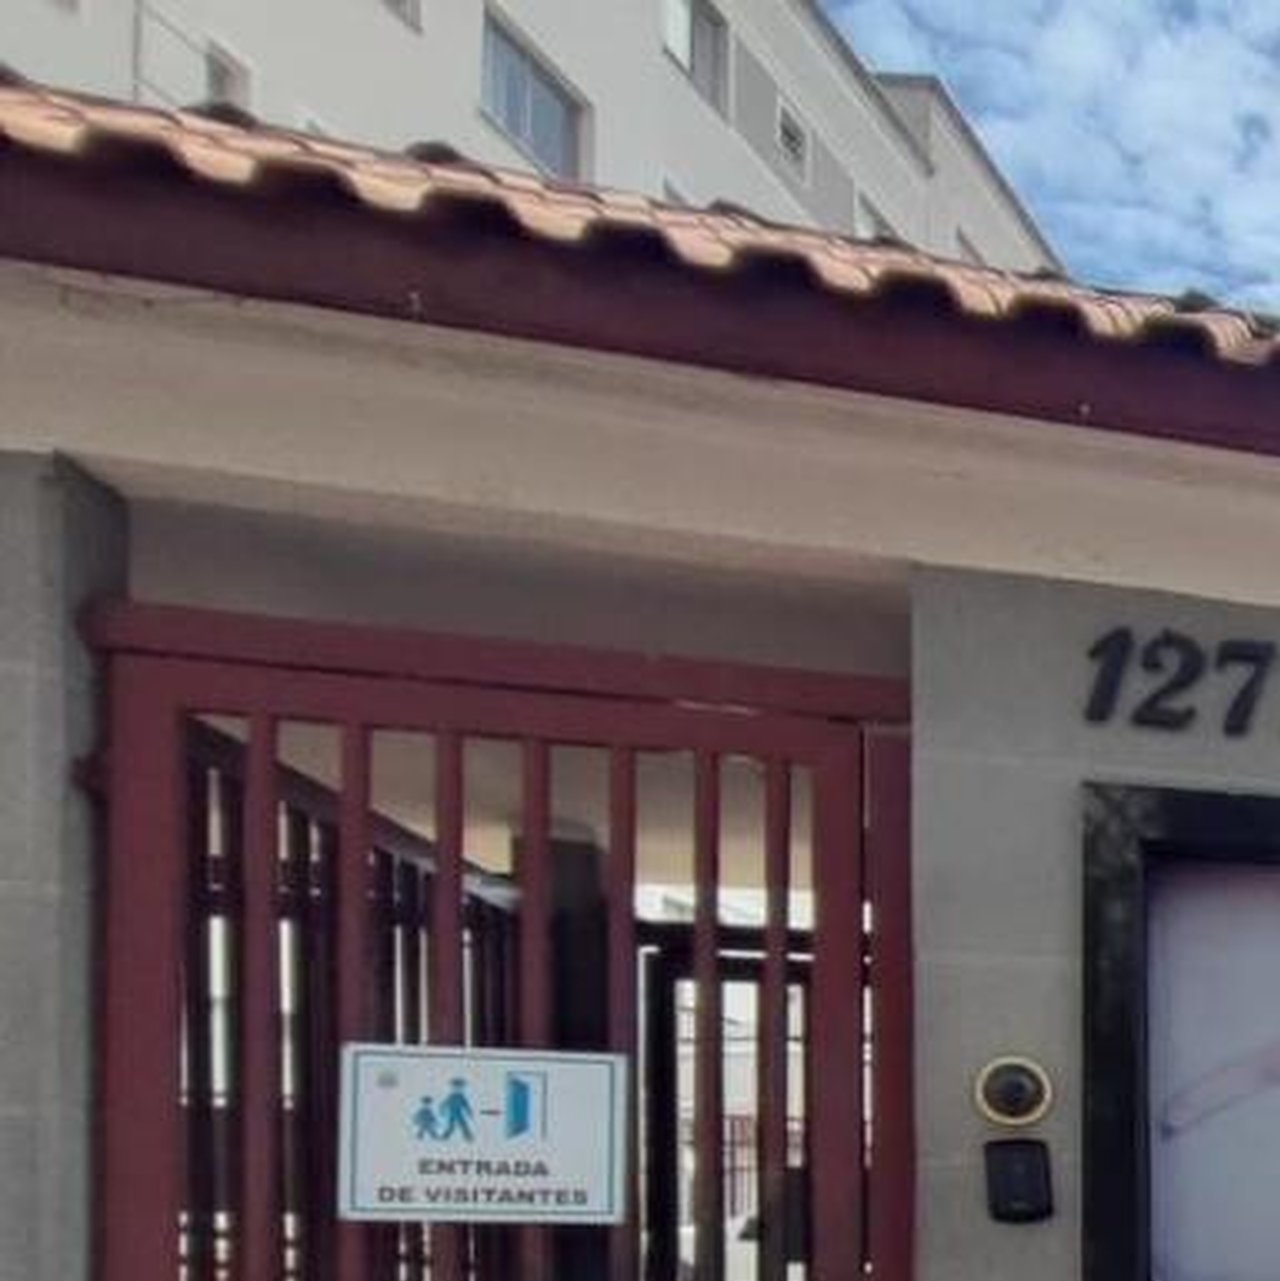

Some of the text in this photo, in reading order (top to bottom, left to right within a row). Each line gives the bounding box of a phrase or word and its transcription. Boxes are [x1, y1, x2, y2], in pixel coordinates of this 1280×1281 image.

[418, 1158, 551, 1178] ENTRADA
[377, 1186, 589, 1206] DE VISITANTES
